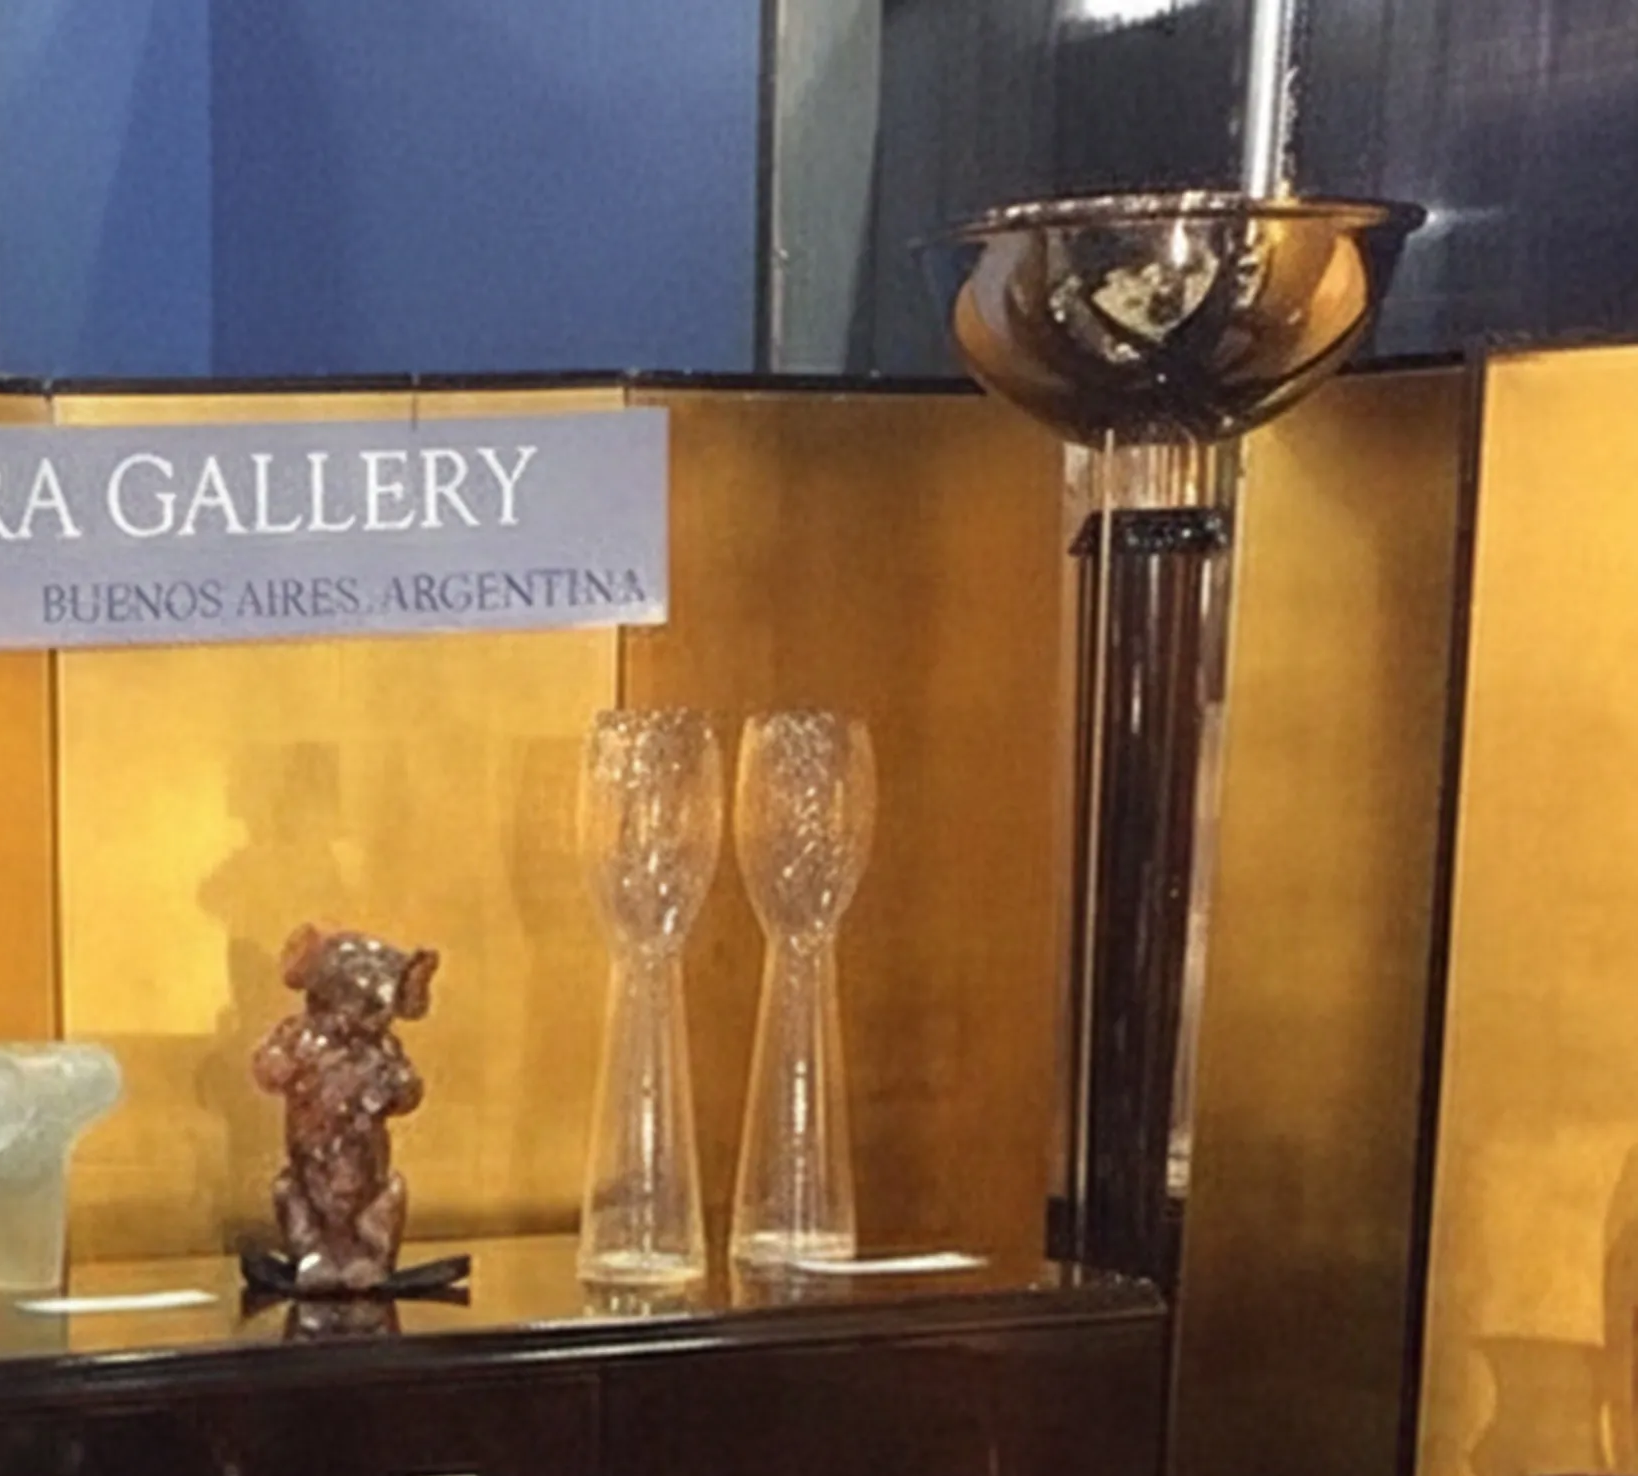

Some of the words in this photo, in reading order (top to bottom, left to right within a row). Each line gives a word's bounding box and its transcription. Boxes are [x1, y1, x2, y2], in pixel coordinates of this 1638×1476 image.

[106, 445, 539, 539] GALLERY
[42, 578, 225, 624] BUENOS
[382, 567, 648, 613] ARGENTINA
